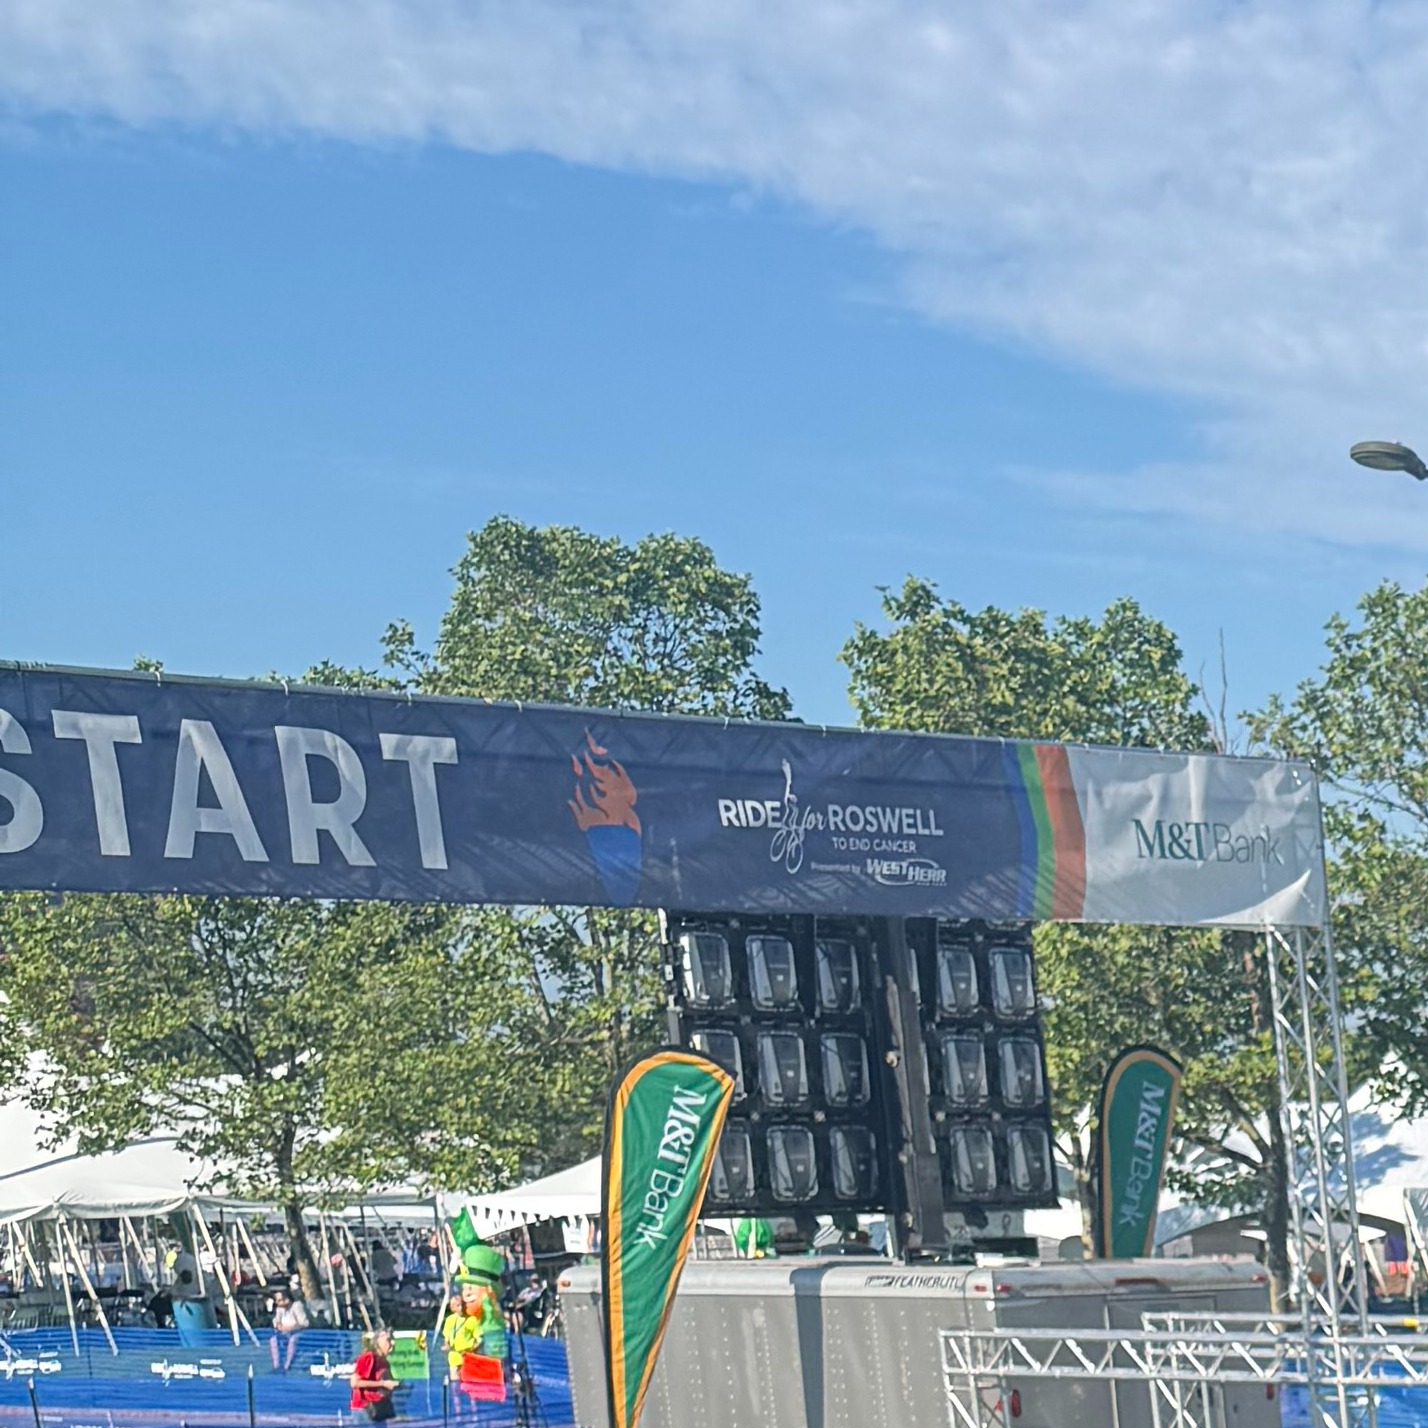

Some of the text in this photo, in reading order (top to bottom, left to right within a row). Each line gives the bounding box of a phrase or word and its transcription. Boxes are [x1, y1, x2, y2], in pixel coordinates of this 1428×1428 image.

[718, 799, 944, 840] RIDE for ROSWELL
[832, 837, 917, 854] TO END CANCER
[1132, 818, 1284, 866] M&T Bank
[866, 858, 947, 882] WEST HERR
[633, 1083, 707, 1250] M&T Bank
[1119, 1080, 1165, 1227] M&T Bank
